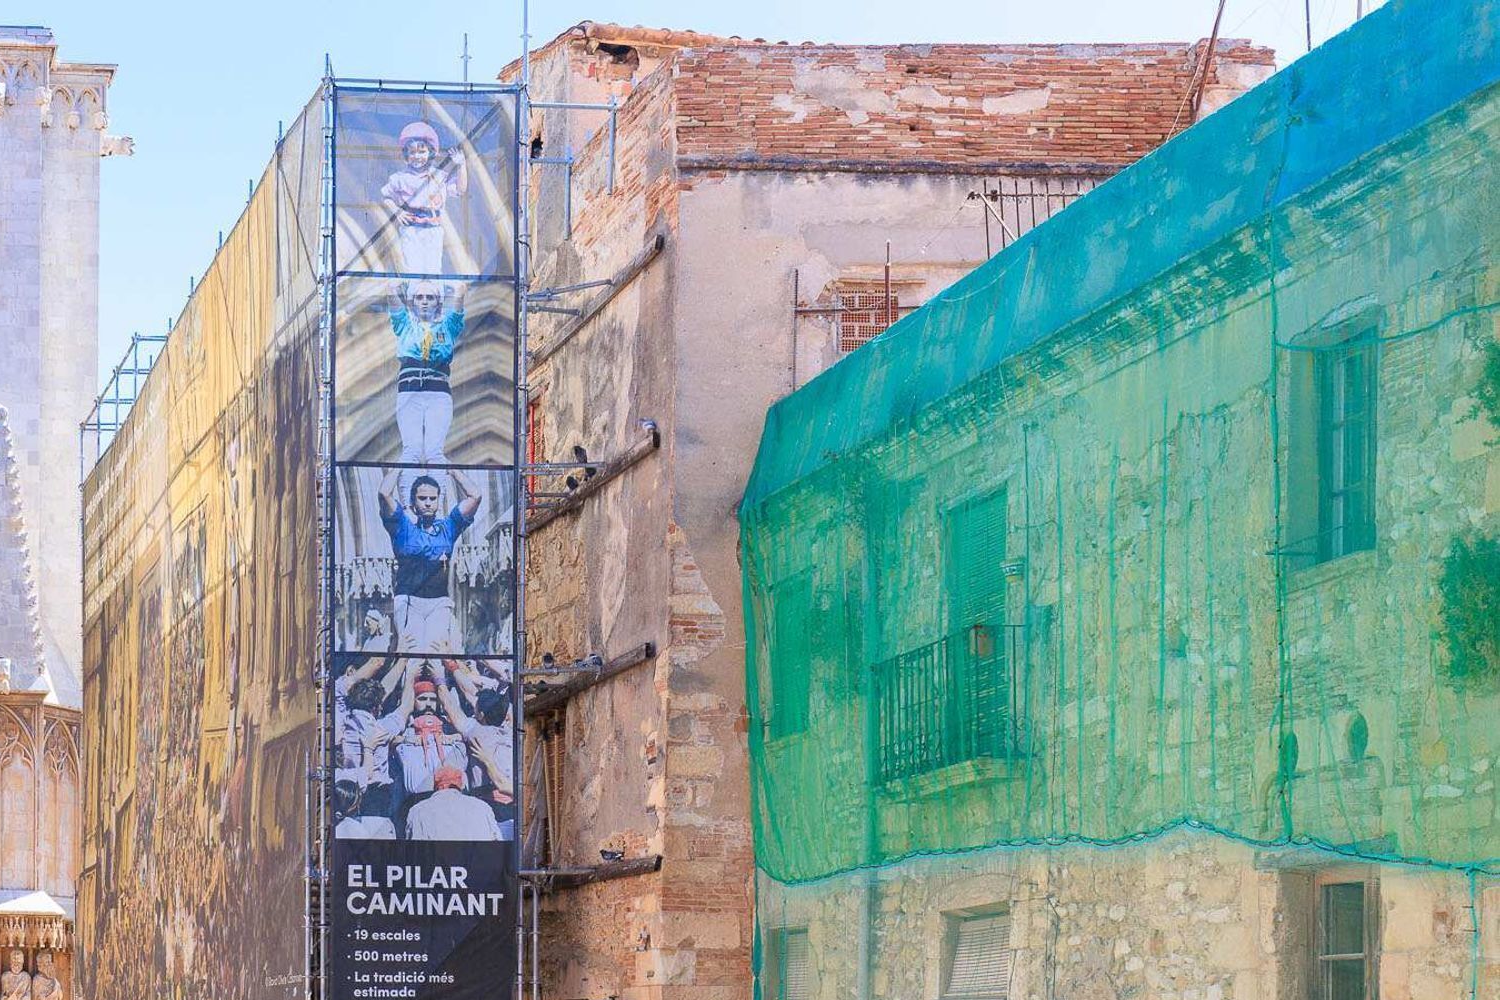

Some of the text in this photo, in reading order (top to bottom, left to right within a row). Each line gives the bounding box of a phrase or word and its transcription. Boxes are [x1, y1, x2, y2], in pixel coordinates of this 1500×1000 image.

[347, 864, 468, 889] EL PILAR
[346, 891, 504, 916] CAMINANT
[354, 929, 421, 941] 19 escales
[354, 950, 429, 962] 500 metres
[354, 971, 455, 984] La tradició més
[353, 986, 416, 998] estimada
